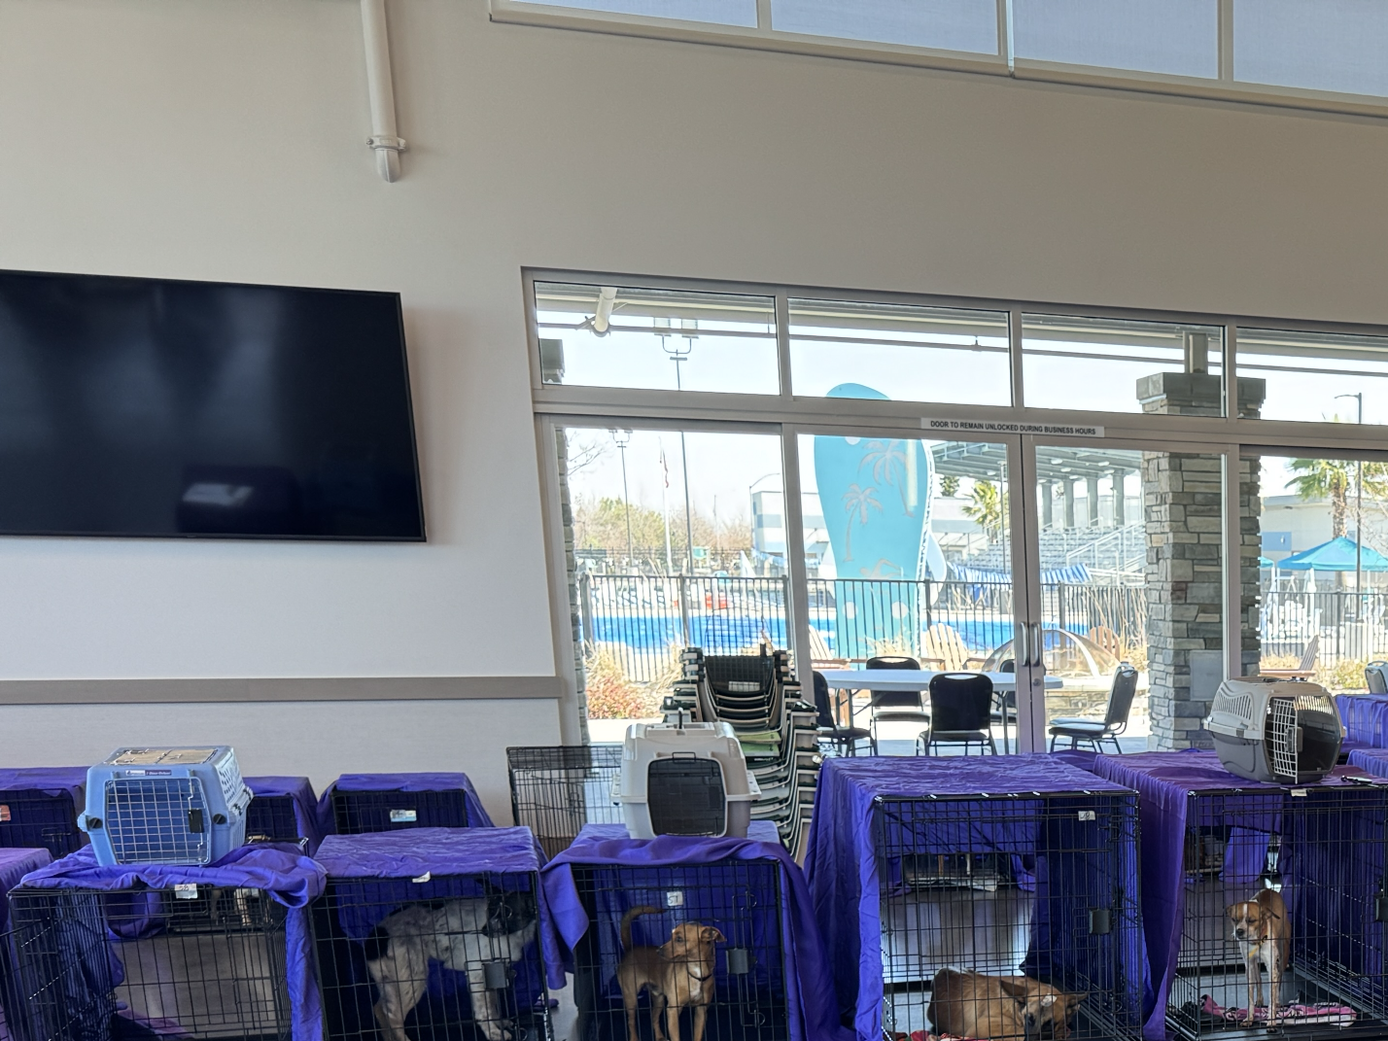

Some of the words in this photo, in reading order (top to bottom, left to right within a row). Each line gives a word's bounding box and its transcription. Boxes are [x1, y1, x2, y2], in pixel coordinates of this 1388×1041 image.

[930, 420, 949, 428] DOOR
[950, 421, 959, 429] TO
[960, 422, 984, 430] REMAIN
[985, 423, 1018, 431] UNLOCKED
[1019, 424, 1043, 433] DURING
[1044, 425, 1074, 434] BUSINESS
[1075, 427, 1096, 435] HOURS
